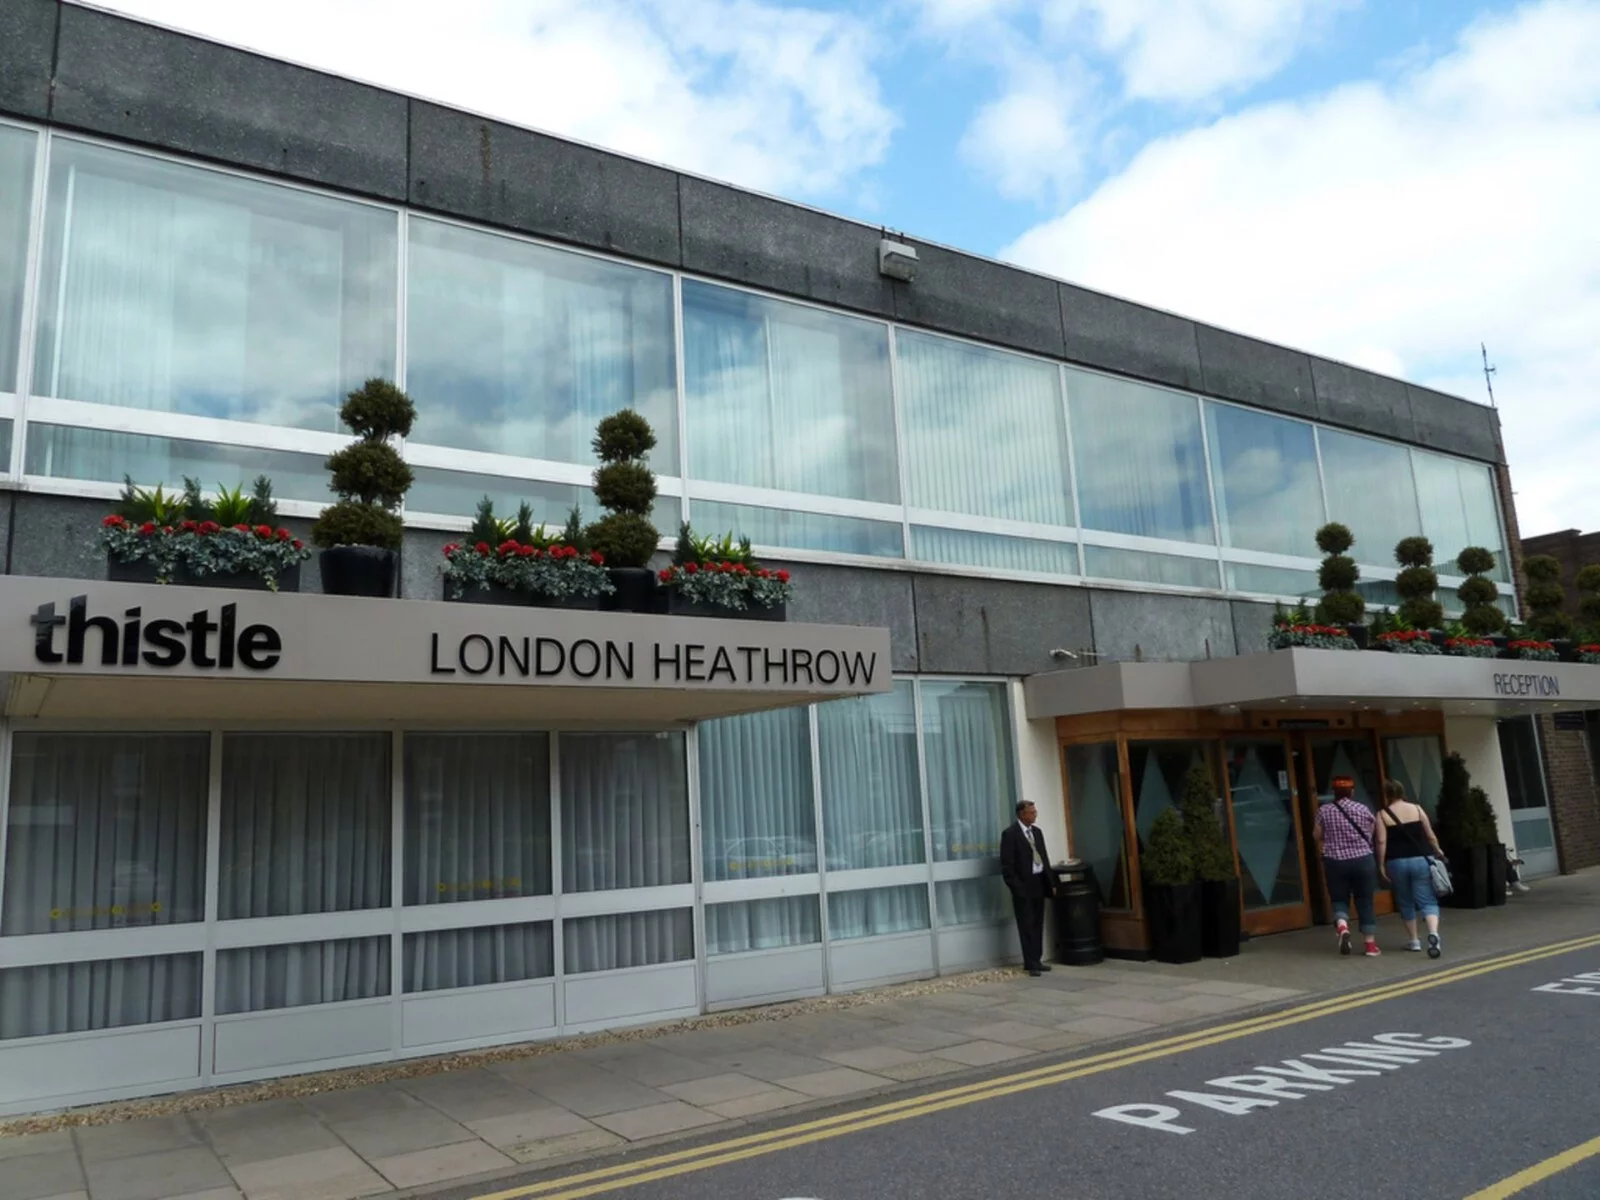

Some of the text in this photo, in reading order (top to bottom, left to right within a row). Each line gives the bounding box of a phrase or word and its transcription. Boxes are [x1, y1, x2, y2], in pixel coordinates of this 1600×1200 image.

[31, 594, 282, 669] thistle
[430, 633, 877, 685] LONDON HEATHROW
[1493, 673, 1560, 696] RECEPTION
[1091, 1032, 1472, 1135] PARKING
